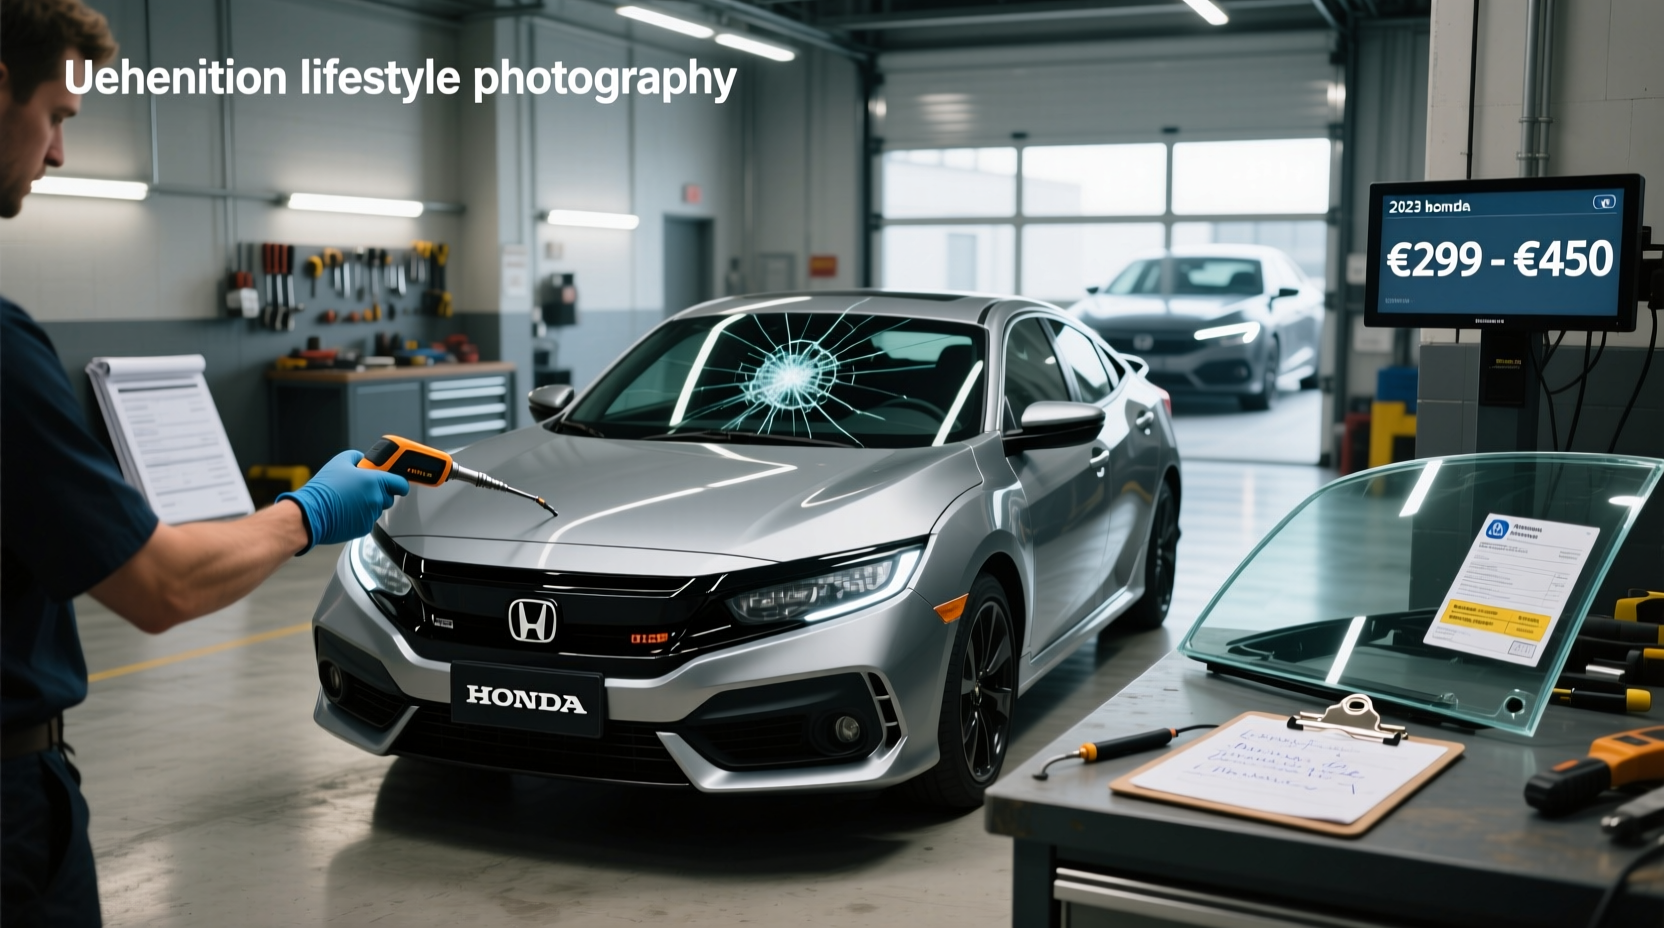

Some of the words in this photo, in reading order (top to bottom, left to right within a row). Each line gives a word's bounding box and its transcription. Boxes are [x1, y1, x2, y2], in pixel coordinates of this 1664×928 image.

[1389, 200, 1421, 214] 2023
[1386, 240, 1483, 278] €299
[1513, 239, 1614, 278] €450
[466, 684, 588, 715] HONDA
